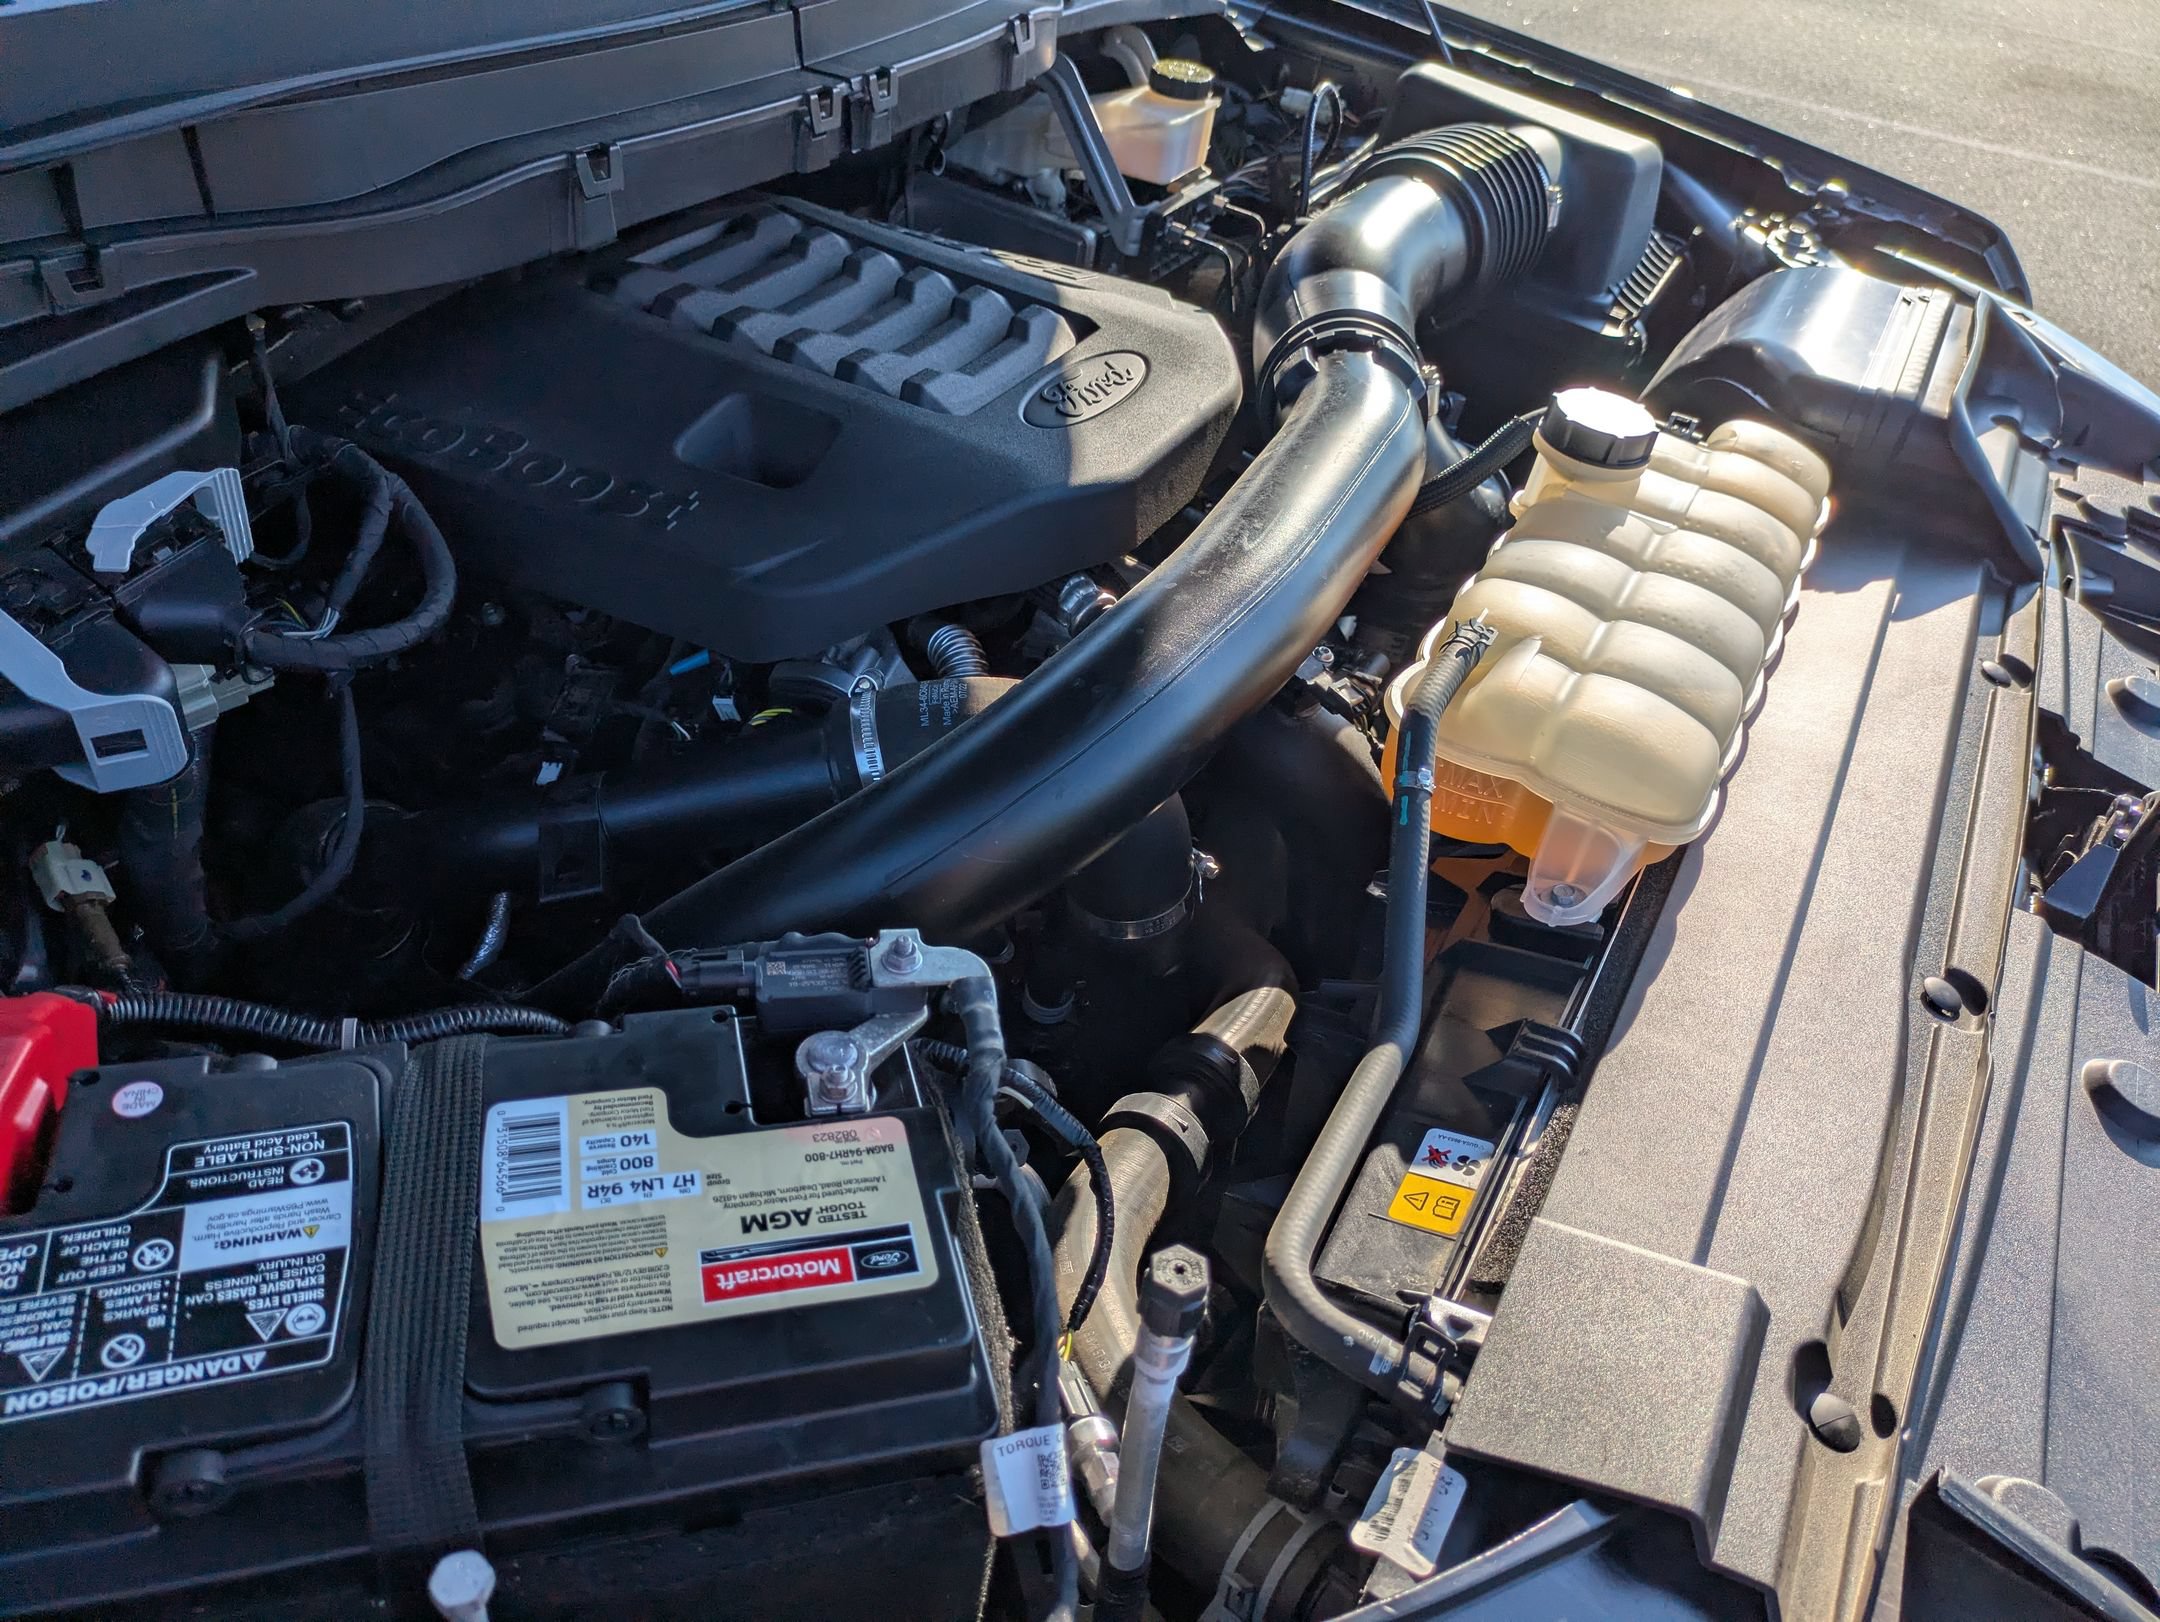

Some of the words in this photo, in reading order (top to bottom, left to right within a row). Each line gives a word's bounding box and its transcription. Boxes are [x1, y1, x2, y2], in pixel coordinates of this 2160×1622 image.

[1041, 360, 1134, 418] Ford
[943, 705, 951, 726] Made
[1443, 765, 1503, 798] MAX
[1434, 792, 1495, 824] MIN
[123, 1087, 160, 1099] CHINA
[616, 1095, 636, 1103] Motor
[602, 1097, 653, 1111] Recommended
[254, 1135, 283, 1148] Acid
[286, 1130, 317, 1143] Lead
[494, 1126, 509, 1156] 31508
[585, 1136, 615, 1146] Capacity
[620, 1131, 650, 1148] 140
[812, 1127, 857, 1143] 082823
[194, 1138, 325, 1167] NON-SPILLABLE
[203, 1138, 250, 1155] Battery
[588, 1142, 615, 1151] Reserve
[804, 1141, 894, 1164] BAGM-94RH7-800
[586, 1162, 617, 1172] Cranking
[596, 1156, 616, 1165] Amps
[619, 1154, 653, 1171] 800
[185, 1165, 284, 1188] INSTRUCTIONS.
[247, 1175, 283, 1188] READ
[493, 1161, 507, 1194] 64566
[672, 1172, 695, 1188] H7
[706, 1172, 721, 1180] Size
[706, 1177, 730, 1187] Group
[842, 1174, 880, 1187] American
[586, 1182, 622, 1198] 94R
[629, 1176, 664, 1193] LN4
[777, 1182, 817, 1196] Dearborn,
[819, 1179, 841, 1190] Road,
[821, 1183, 878, 1199] Manufactured
[712, 1193, 737, 1203] 48126
[738, 1187, 776, 1200] Michigan
[763, 1195, 787, 1206] Motor
[788, 1193, 807, 1203] Ford
[809, 1192, 820, 1200] for
[304, 1205, 330, 1216] Wash
[723, 1197, 762, 1211] Company
[250, 1215, 270, 1224] after
[273, 1210, 300, 1221] hands
[287, 1217, 304, 1227] and
[308, 1211, 341, 1224] Cancer
[739, 1205, 814, 1234] AGM
[817, 1209, 866, 1224] TESTED
[58, 1224, 131, 1244] CHILDREN.
[223, 1219, 284, 1238] Reproductive
[191, 1231, 220, 1242] Harm.
[213, 1226, 301, 1251] WARNING:
[59, 1245, 80, 1256] OF
[82, 1237, 129, 1253] REACH
[79, 1253, 105, 1266] THE
[108, 1250, 128, 1261] OF
[256, 1254, 304, 1272] INJURY.
[306, 1252, 325, 1264] OR
[868, 1249, 901, 1267] Ford
[56, 1268, 85, 1283] OUT
[88, 1262, 125, 1278] KEEP
[282, 1262, 325, 1279] CAUSE
[714, 1255, 841, 1291] Motorcraft
[204, 1269, 278, 1292] BLINDNESS
[259, 1272, 324, 1295] EXPLOSIVE
[96, 1278, 161, 1299] SMOKING
[216, 1284, 256, 1302] GASES
[280, 1286, 324, 1305] SHIELD
[635, 1286, 671, 1298] Warranty
[104, 1290, 160, 1309] FLAMES
[184, 1291, 214, 1306] CAN
[243, 1294, 279, 1311] EYES.
[594, 1295, 608, 1304] tag
[616, 1292, 634, 1301] void
[102, 1302, 159, 1322] SPARKS
[629, 1306, 647, 1316] Keep
[41, 1318, 72, 1333] CAN
[146, 1313, 165, 1329] NO
[517, 1320, 550, 1332] required
[2, 1351, 241, 1418] DANGER/POISON
[997, 1434, 1051, 1457] TORQUE
